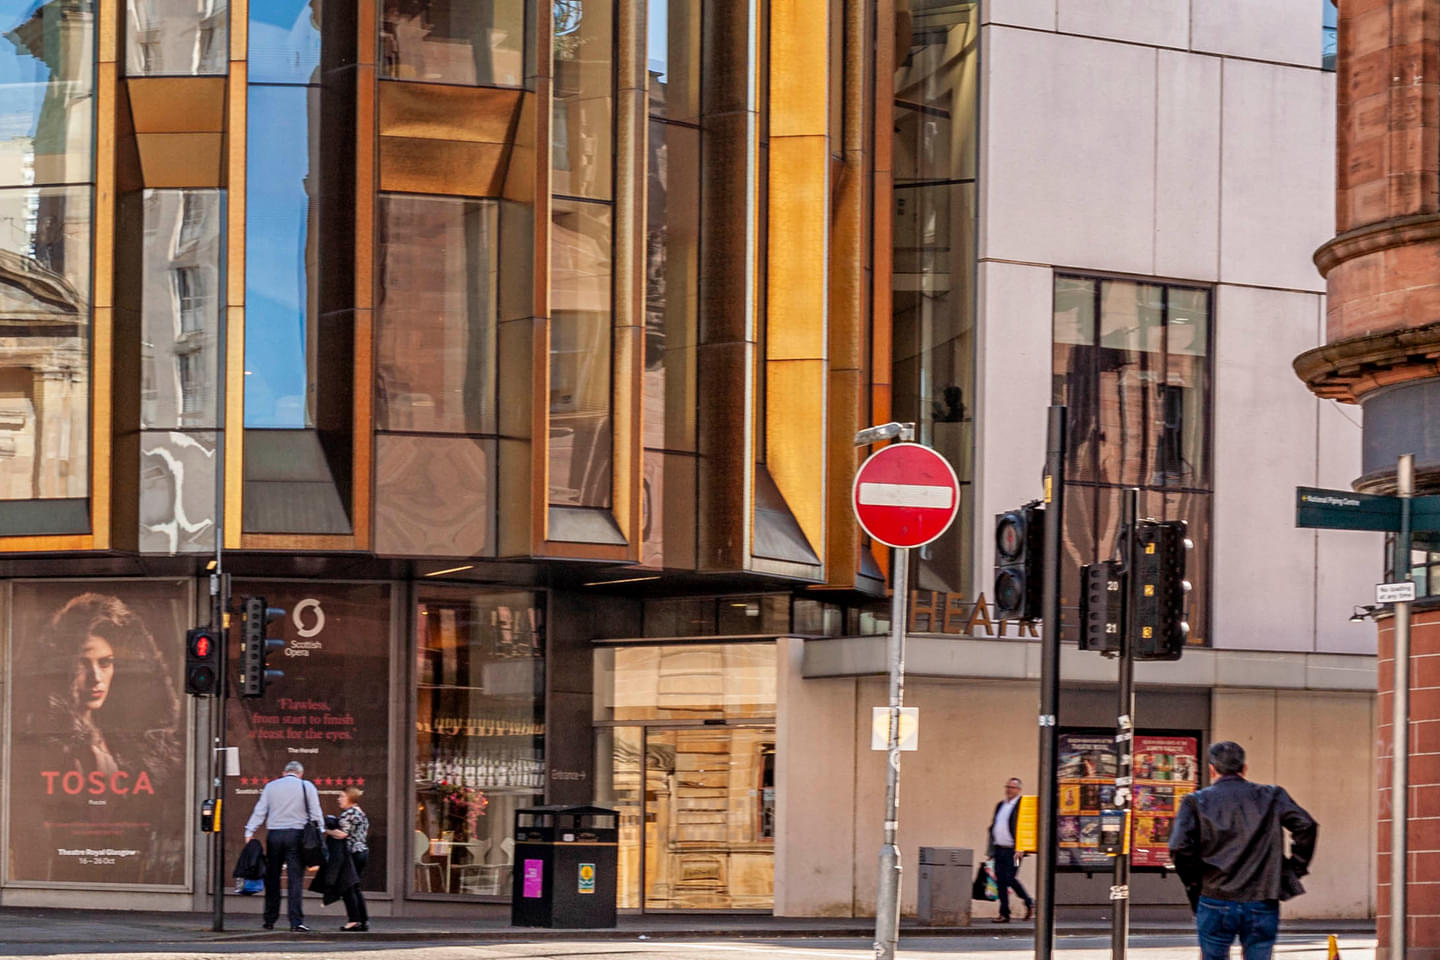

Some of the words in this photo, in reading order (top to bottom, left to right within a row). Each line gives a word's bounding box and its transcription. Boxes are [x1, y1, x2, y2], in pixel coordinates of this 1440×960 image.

[1105, 623, 1117, 633] 21
[290, 640, 322, 649] Scottish
[284, 647, 310, 658] Opera
[282, 714, 307, 724] start
[309, 714, 321, 724] to
[287, 727, 303, 739] for
[305, 727, 323, 739] the
[41, 770, 155, 795] TOSCA
[58, 848, 85, 856] Theatre
[85, 848, 105, 857] Royal
[105, 848, 138, 857] Glasgow
